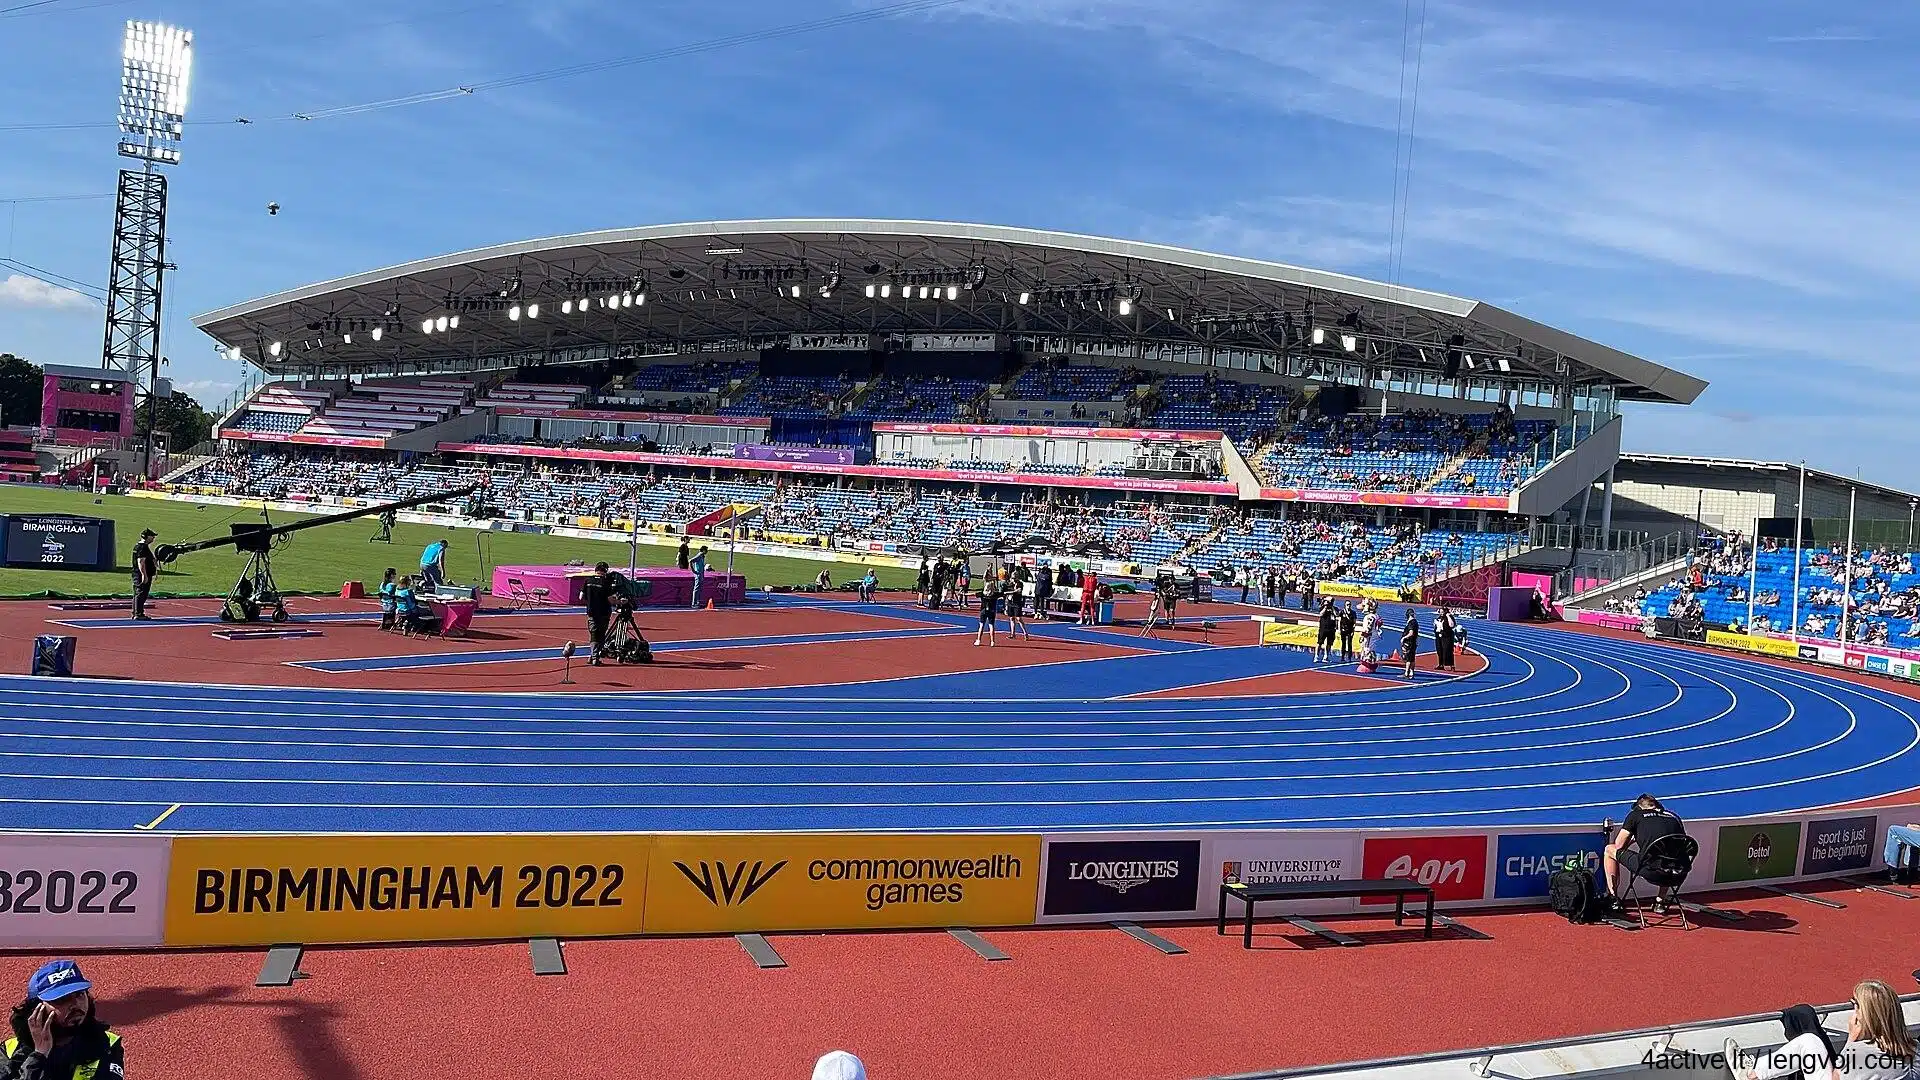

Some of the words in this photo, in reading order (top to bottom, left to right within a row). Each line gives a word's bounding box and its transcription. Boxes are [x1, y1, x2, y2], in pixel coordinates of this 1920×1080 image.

[22, 523, 87, 533] BIRMINGHAM
[41, 554, 64, 563] 2022
[1818, 830, 1841, 846] sport
[1843, 830, 1850, 842] is
[1850, 827, 1867, 843] just
[1747, 845, 1770, 859] Dettol
[1812, 845, 1826, 860] the
[1827, 843, 1868, 860] beginning
[808, 855, 1021, 881] commonwealth
[1068, 861, 1179, 880] LONGINES
[1249, 860, 1331, 873] UNIVERSITY
[195, 865, 504, 914] BIRMINGHAM
[515, 864, 624, 908] 2022
[866, 882, 963, 911] games
